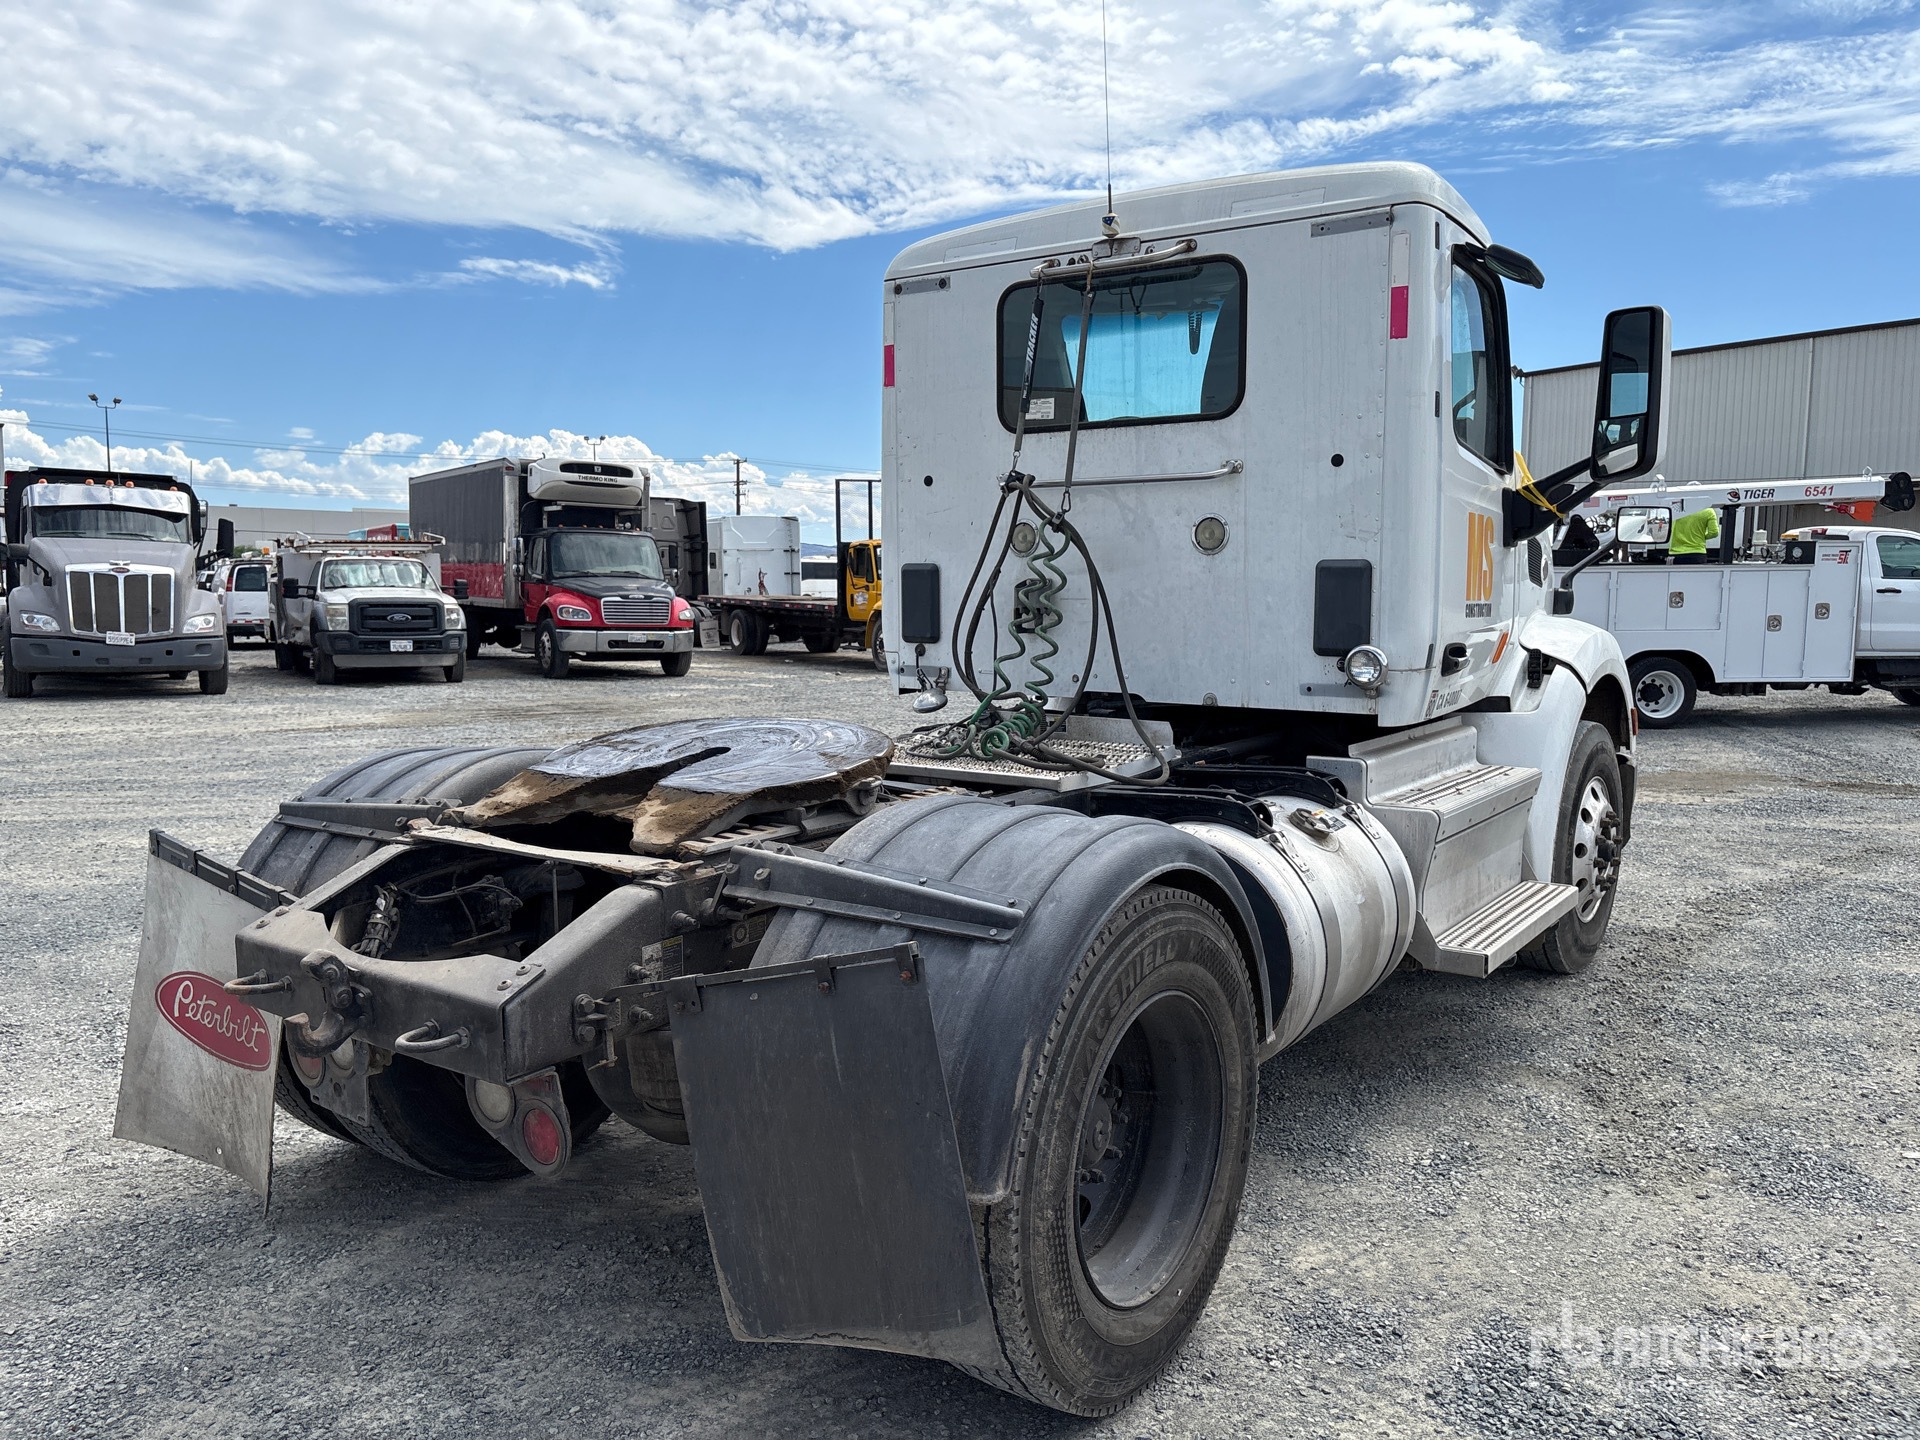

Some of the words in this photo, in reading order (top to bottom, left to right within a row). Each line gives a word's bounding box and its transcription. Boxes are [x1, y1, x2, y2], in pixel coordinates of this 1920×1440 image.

[1026, 313, 1039, 363] TRACKER
[1743, 488, 1775, 499] TIGER
[1804, 485, 1834, 497] 6541
[173, 980, 266, 1053] Peterbilt
